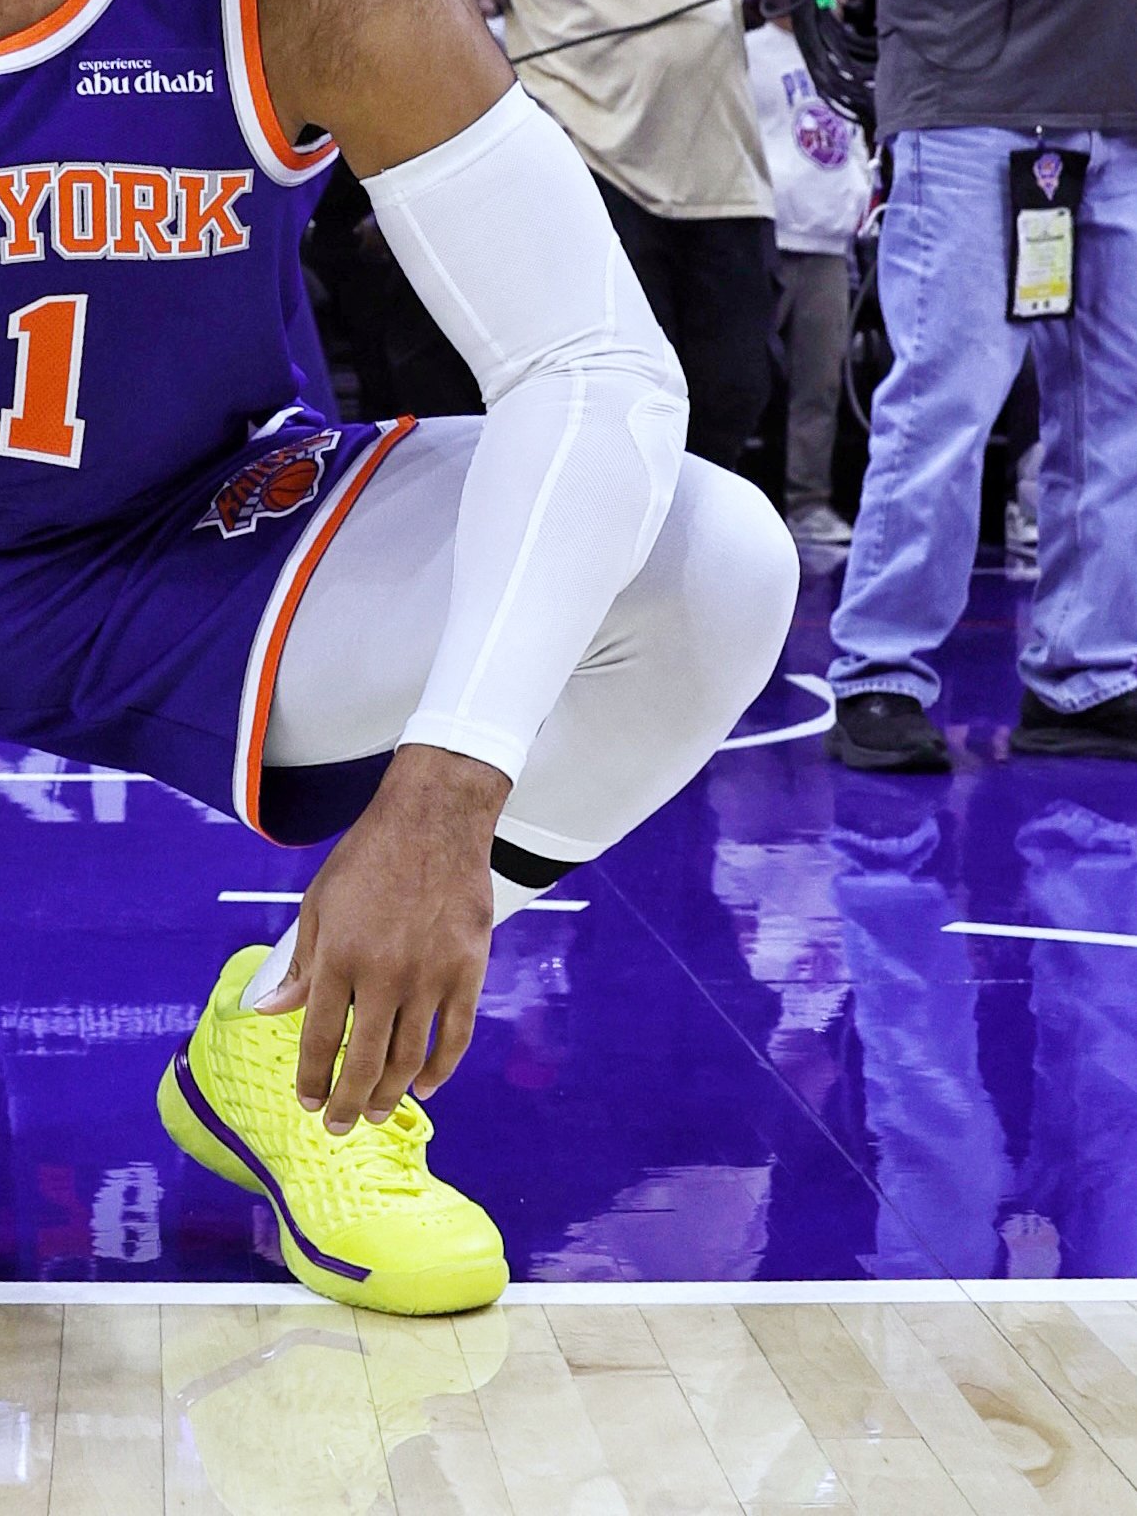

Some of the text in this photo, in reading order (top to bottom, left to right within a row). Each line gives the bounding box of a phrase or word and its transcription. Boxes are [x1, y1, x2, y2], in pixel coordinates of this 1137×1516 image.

[78, 57, 152, 72] experience
[75, 69, 214, 96] abu dhabi
